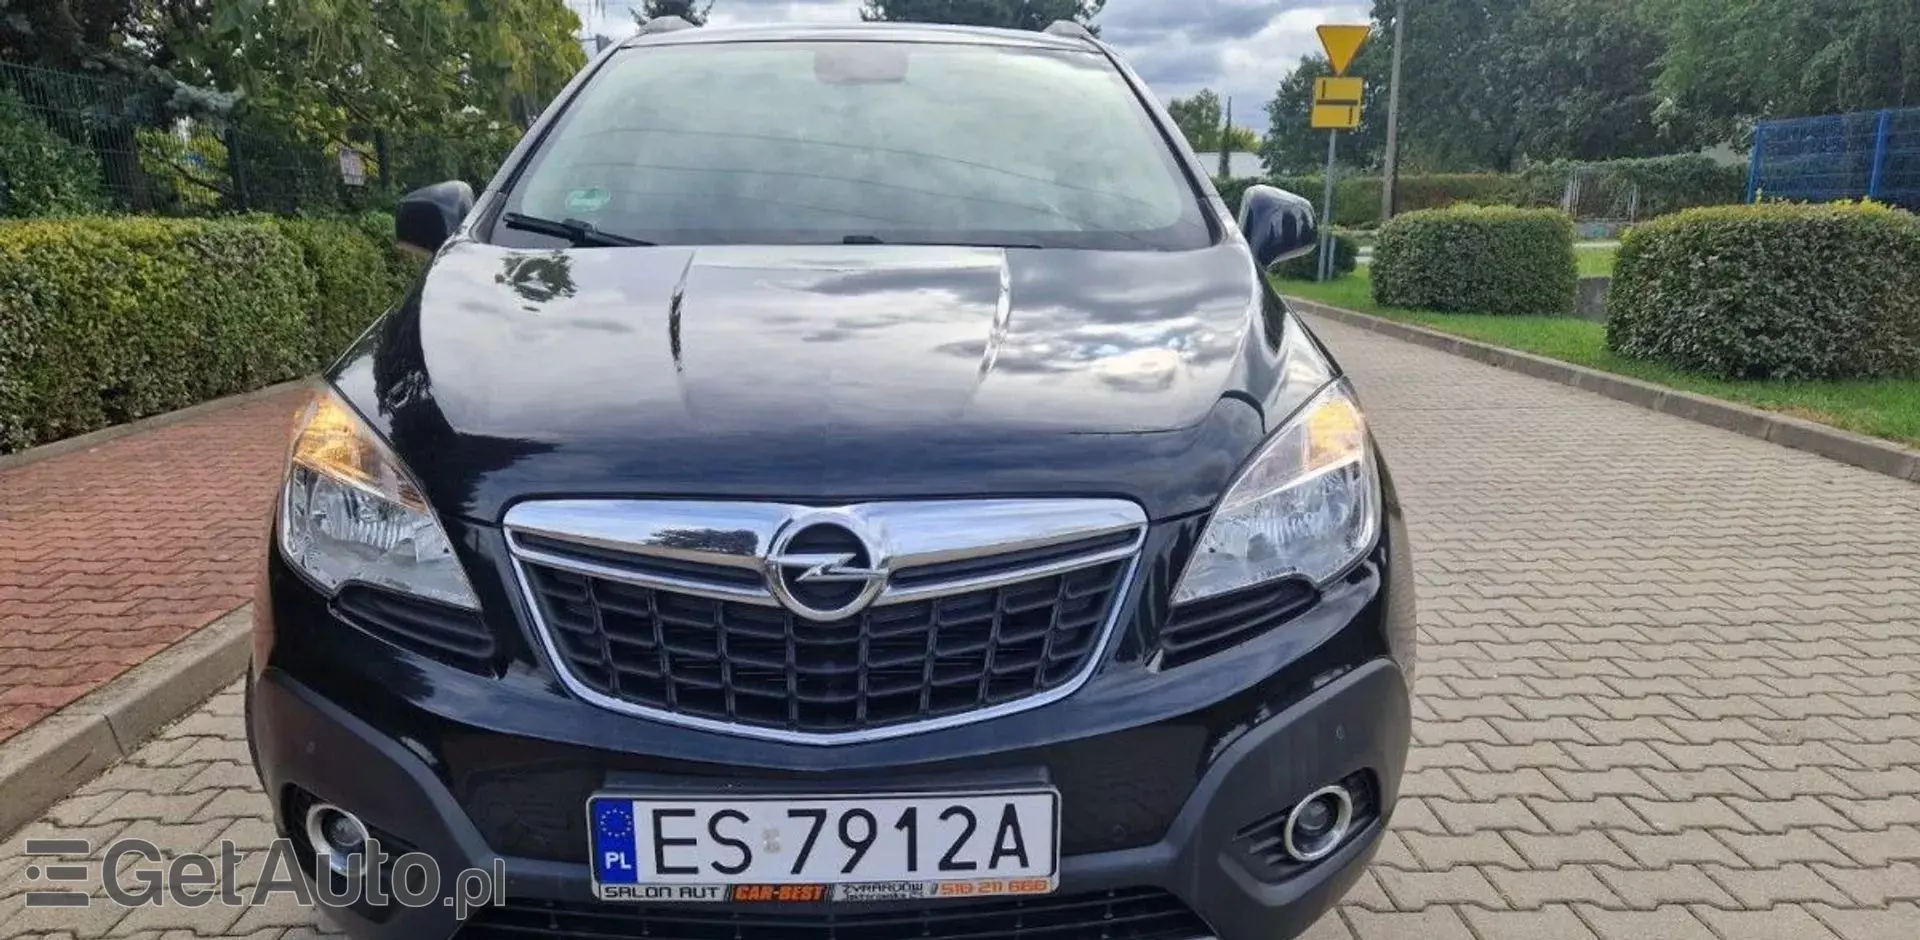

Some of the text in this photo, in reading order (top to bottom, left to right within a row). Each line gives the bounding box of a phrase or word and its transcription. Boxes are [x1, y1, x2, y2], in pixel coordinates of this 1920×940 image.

[652, 803, 1029, 875] ES 7912A
[605, 851, 632, 870] PL
[604, 886, 672, 898] SALON
[735, 885, 825, 900] CAR-BEST
